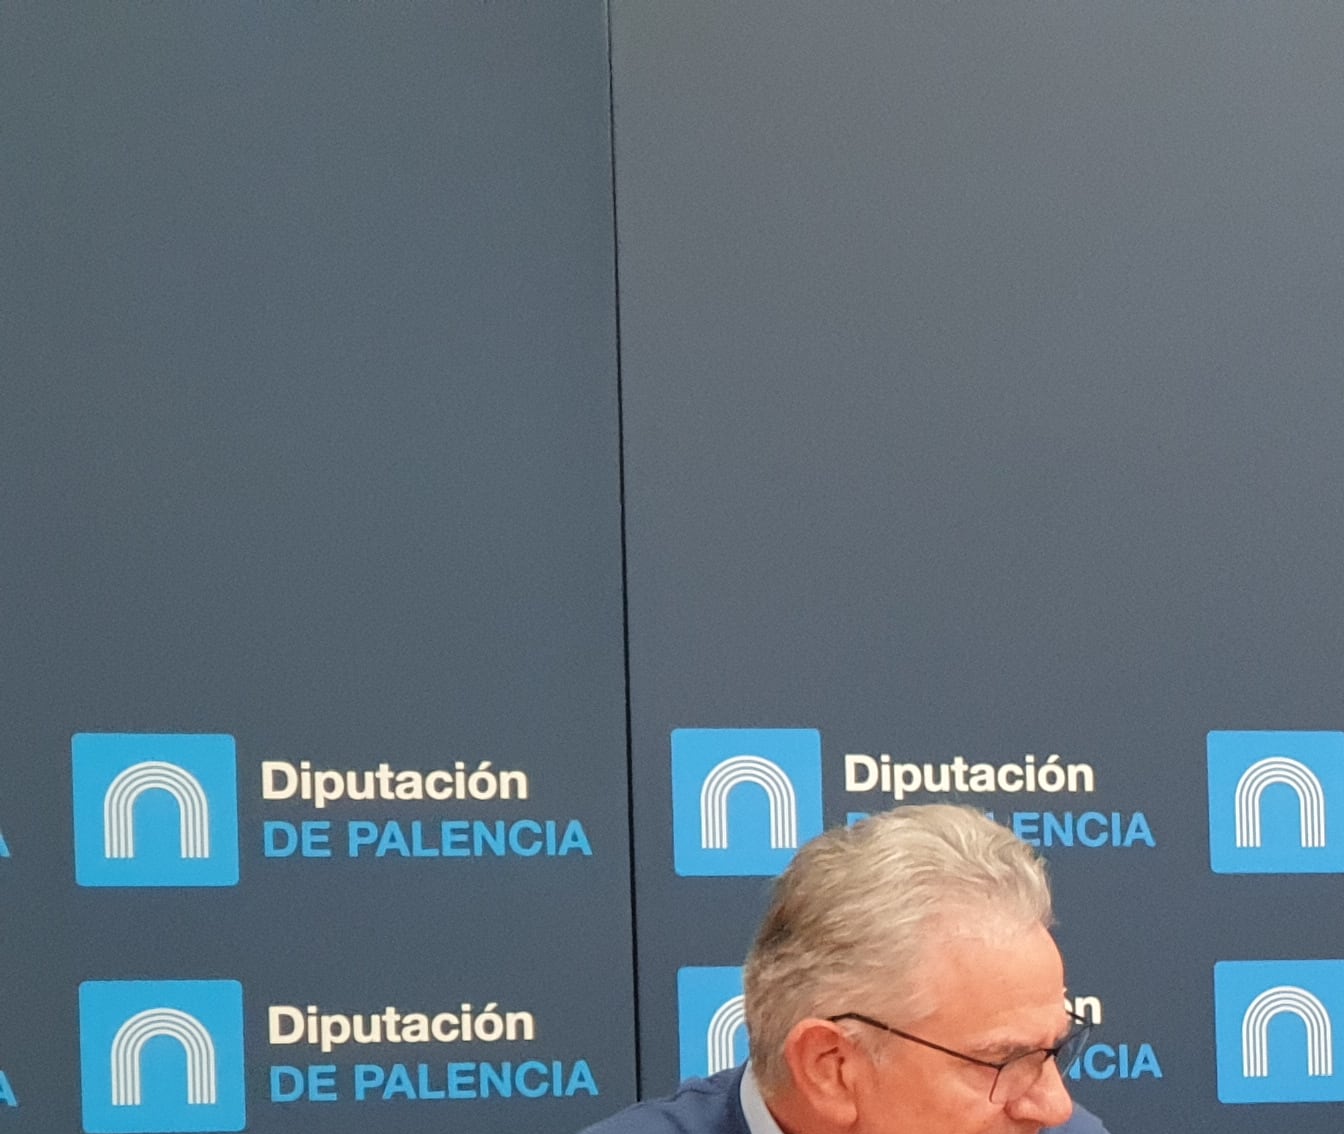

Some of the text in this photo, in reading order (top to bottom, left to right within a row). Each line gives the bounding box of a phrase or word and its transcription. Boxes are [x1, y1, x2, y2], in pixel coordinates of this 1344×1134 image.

[261, 760, 528, 808] Diputación
[844, 753, 1095, 800] Diputación
[263, 819, 593, 858] DE PALENCIA
[1011, 811, 1157, 849] ENCIA
[268, 1002, 534, 1053] Diputación
[270, 1059, 600, 1103] DE PALENCIA
